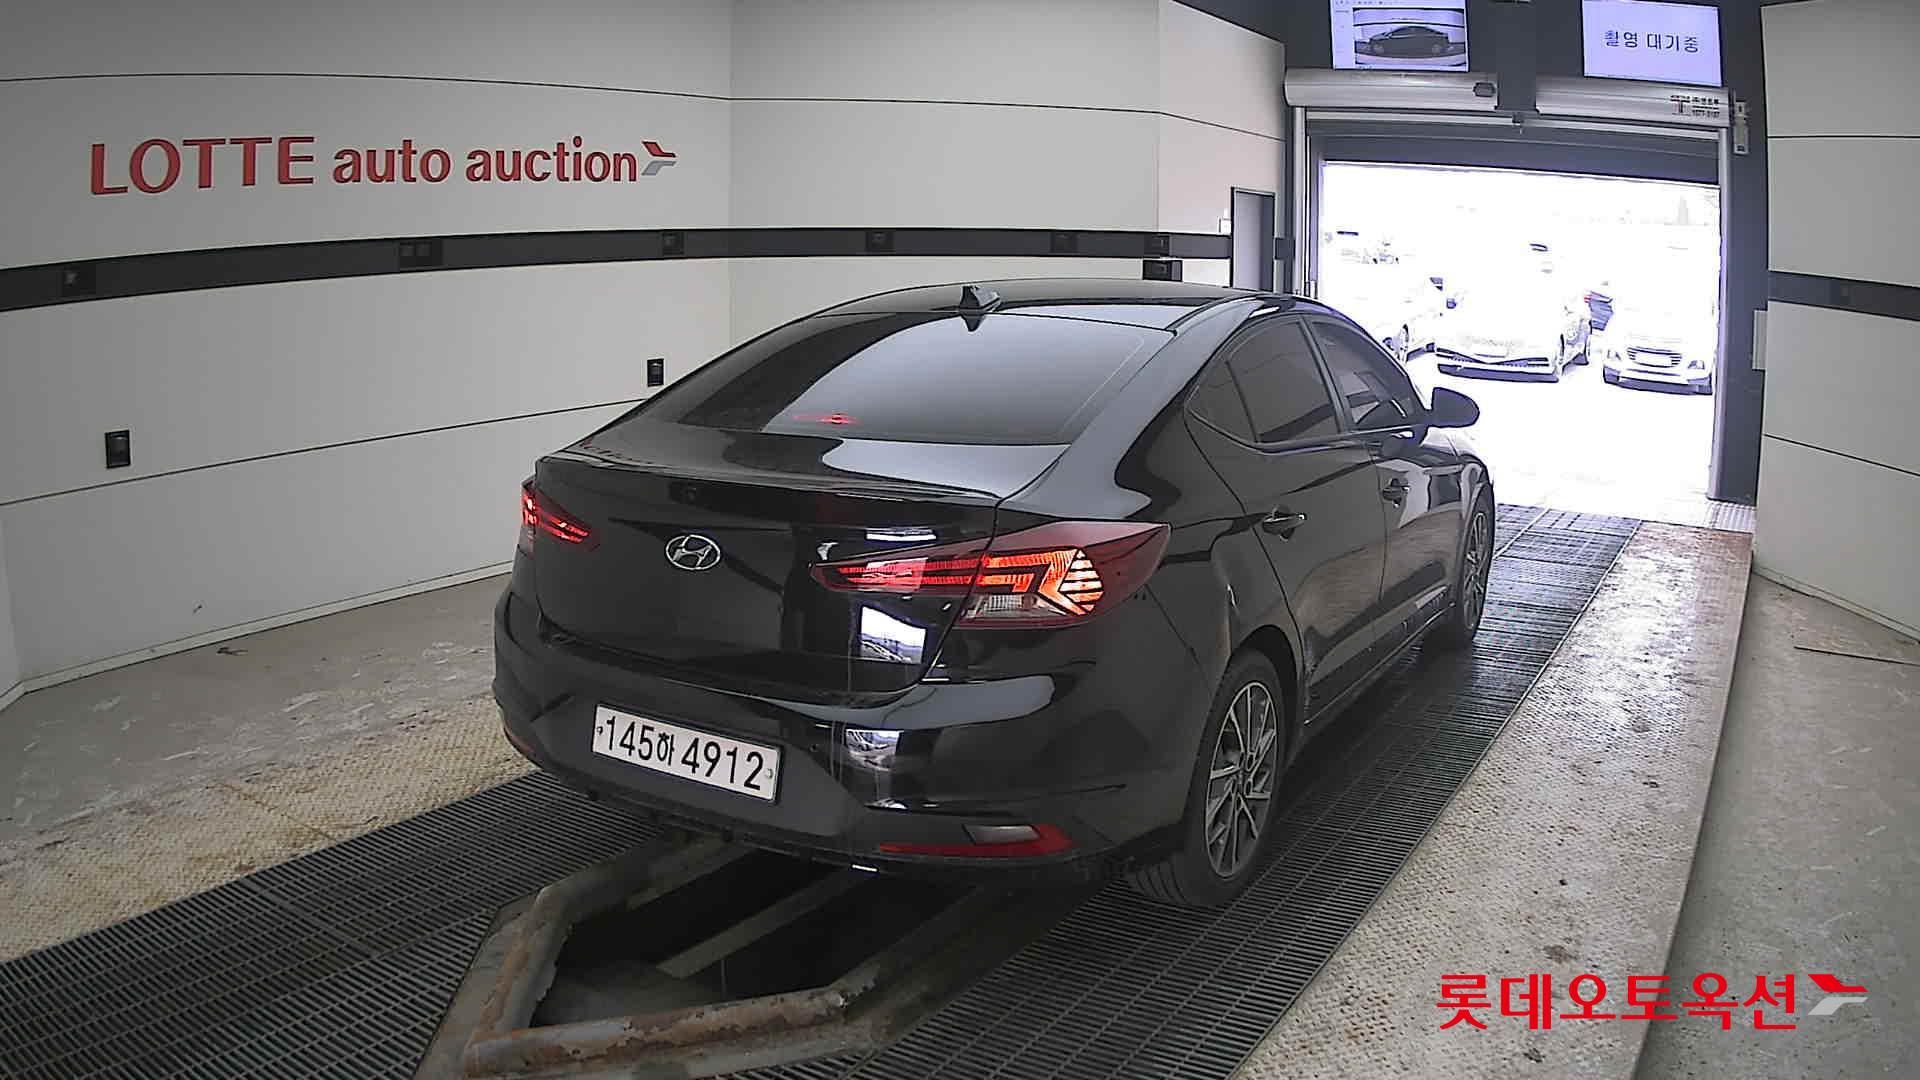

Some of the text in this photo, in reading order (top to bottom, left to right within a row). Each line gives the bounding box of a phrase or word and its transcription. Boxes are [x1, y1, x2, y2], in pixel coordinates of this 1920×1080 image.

[1647, 33, 1699, 53] 대기중
[91, 136, 638, 195] LOTTE auto auction
